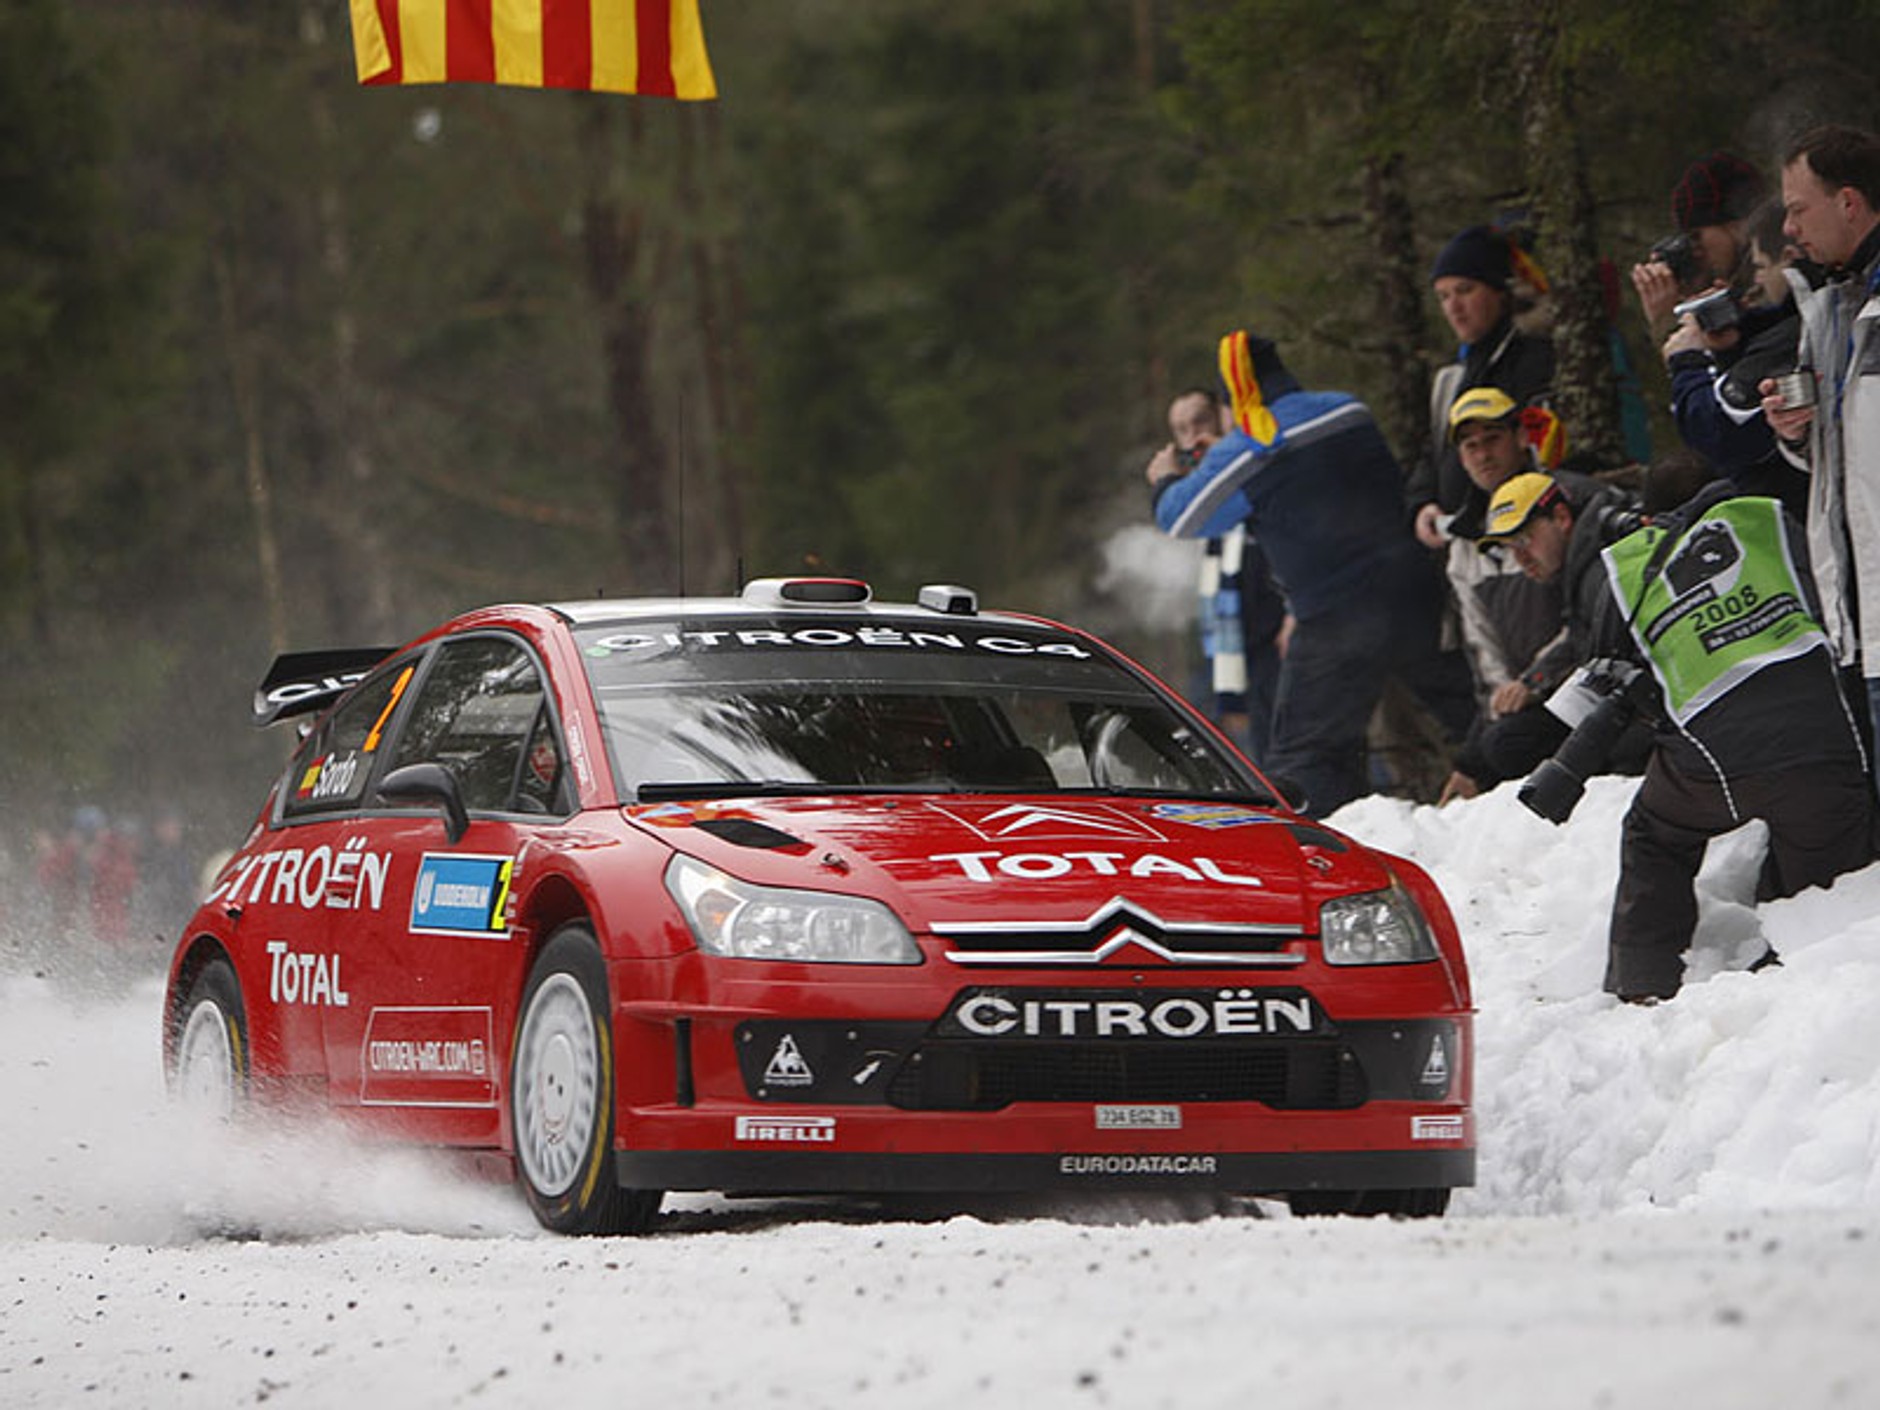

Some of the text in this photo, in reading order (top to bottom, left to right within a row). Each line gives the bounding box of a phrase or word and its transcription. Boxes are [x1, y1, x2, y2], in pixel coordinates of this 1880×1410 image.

[1690, 585, 1758, 632] 2008
[595, 627, 1091, 659] CITROËN C4
[204, 836, 392, 910] CITROËN
[929, 851, 1262, 886] TOTAL
[266, 941, 349, 1007] TOTAL
[955, 989, 1312, 1037] CITROËN
[735, 1116, 836, 1142] PIRELLI
[1060, 1156, 1217, 1174] EURODATACAR
